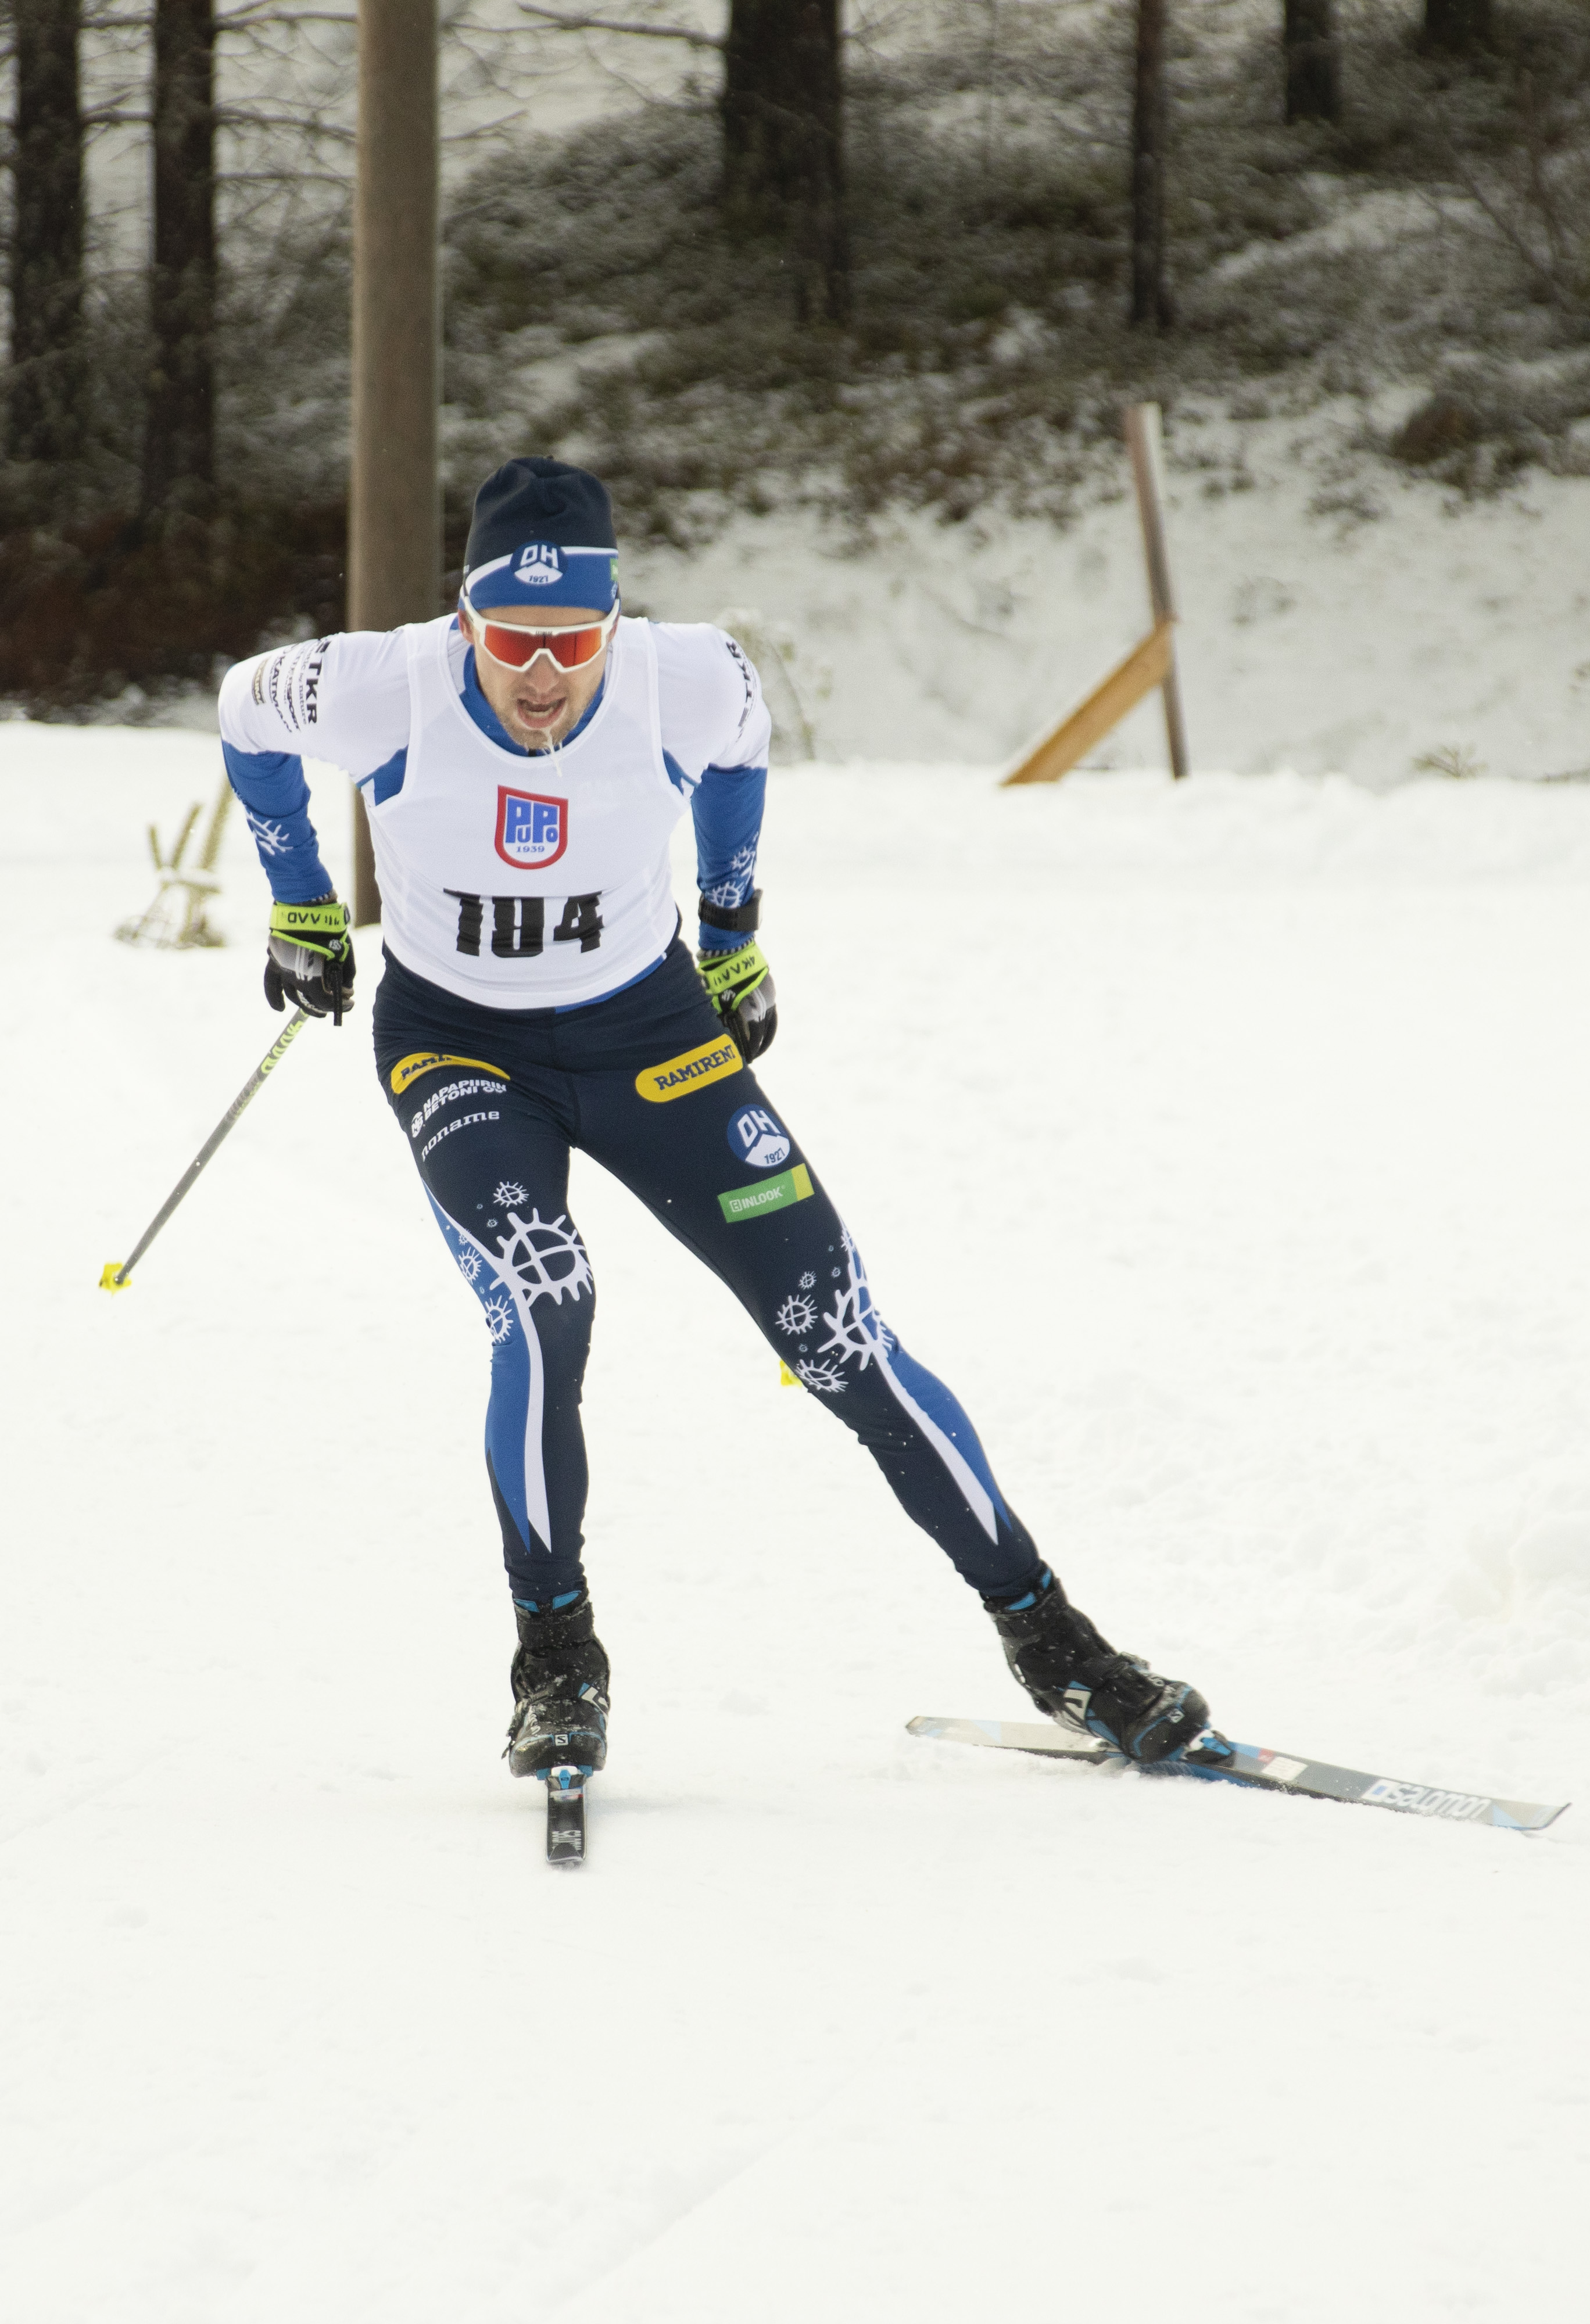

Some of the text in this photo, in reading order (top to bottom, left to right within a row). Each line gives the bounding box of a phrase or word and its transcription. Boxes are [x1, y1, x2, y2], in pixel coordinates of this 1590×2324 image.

[654, 1045, 736, 1091] RAMIRENT
[423, 1079, 507, 1113] NAPAPIIRIN
[424, 1086, 478, 1121] BETONI
[422, 1111, 500, 1162] noname
[764, 1147, 786, 1164] 1927
[742, 1186, 783, 1209] INLOOK
